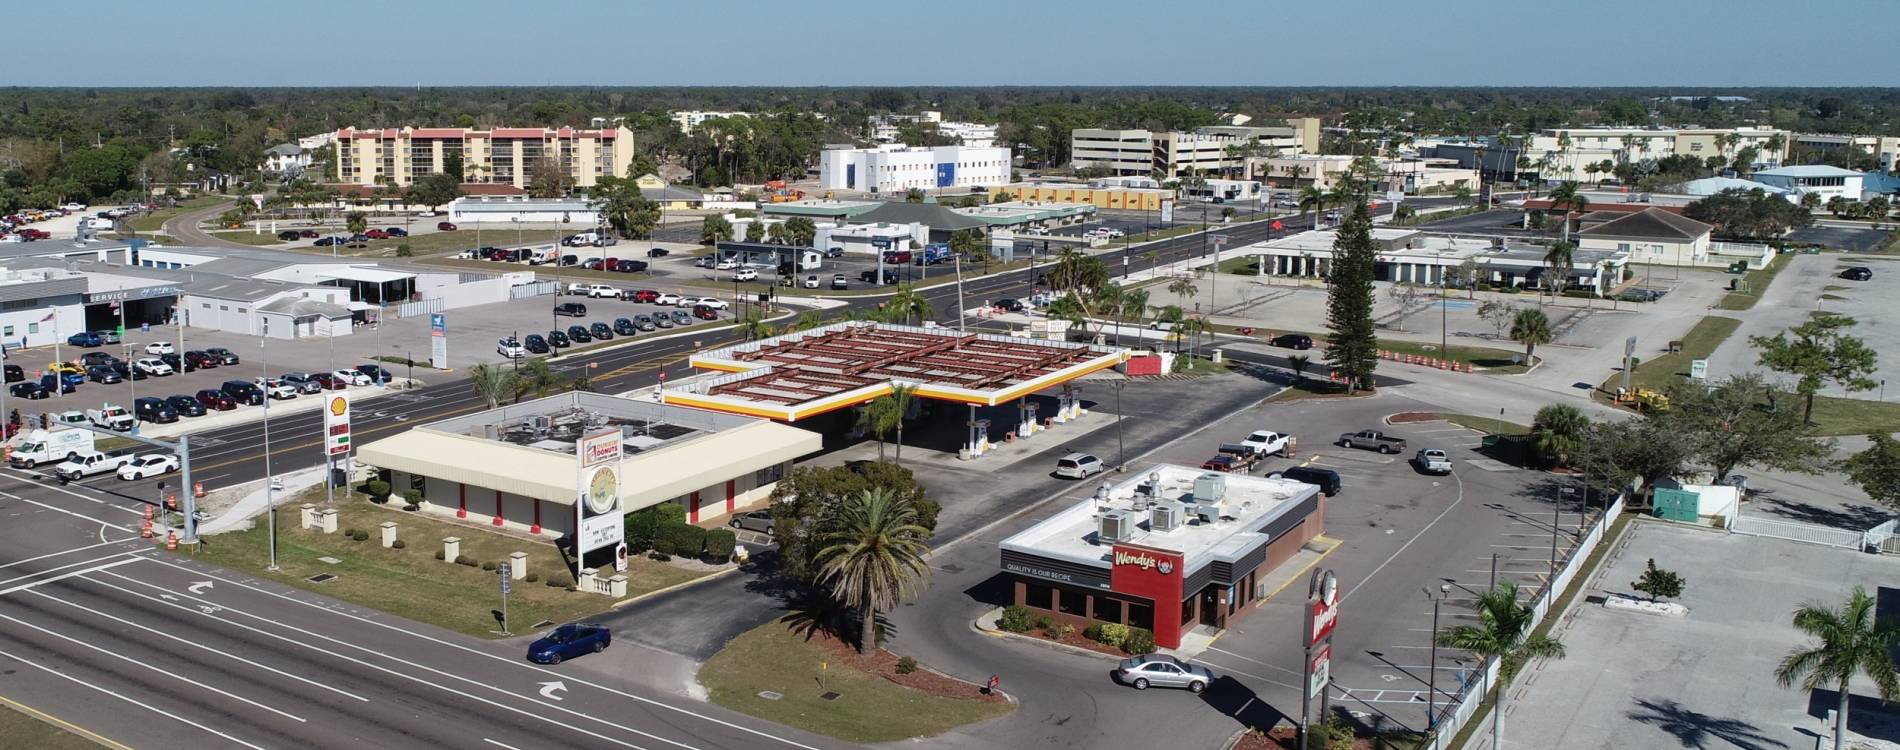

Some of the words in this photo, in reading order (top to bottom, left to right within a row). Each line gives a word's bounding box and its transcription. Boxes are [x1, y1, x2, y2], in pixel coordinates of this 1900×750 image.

[90, 292, 128, 303] SERVICE
[597, 446, 618, 457] DONUTS
[1115, 551, 1155, 571] Wendy's
[1007, 563, 1031, 574] QUALITY
[1038, 570, 1050, 578] OUR
